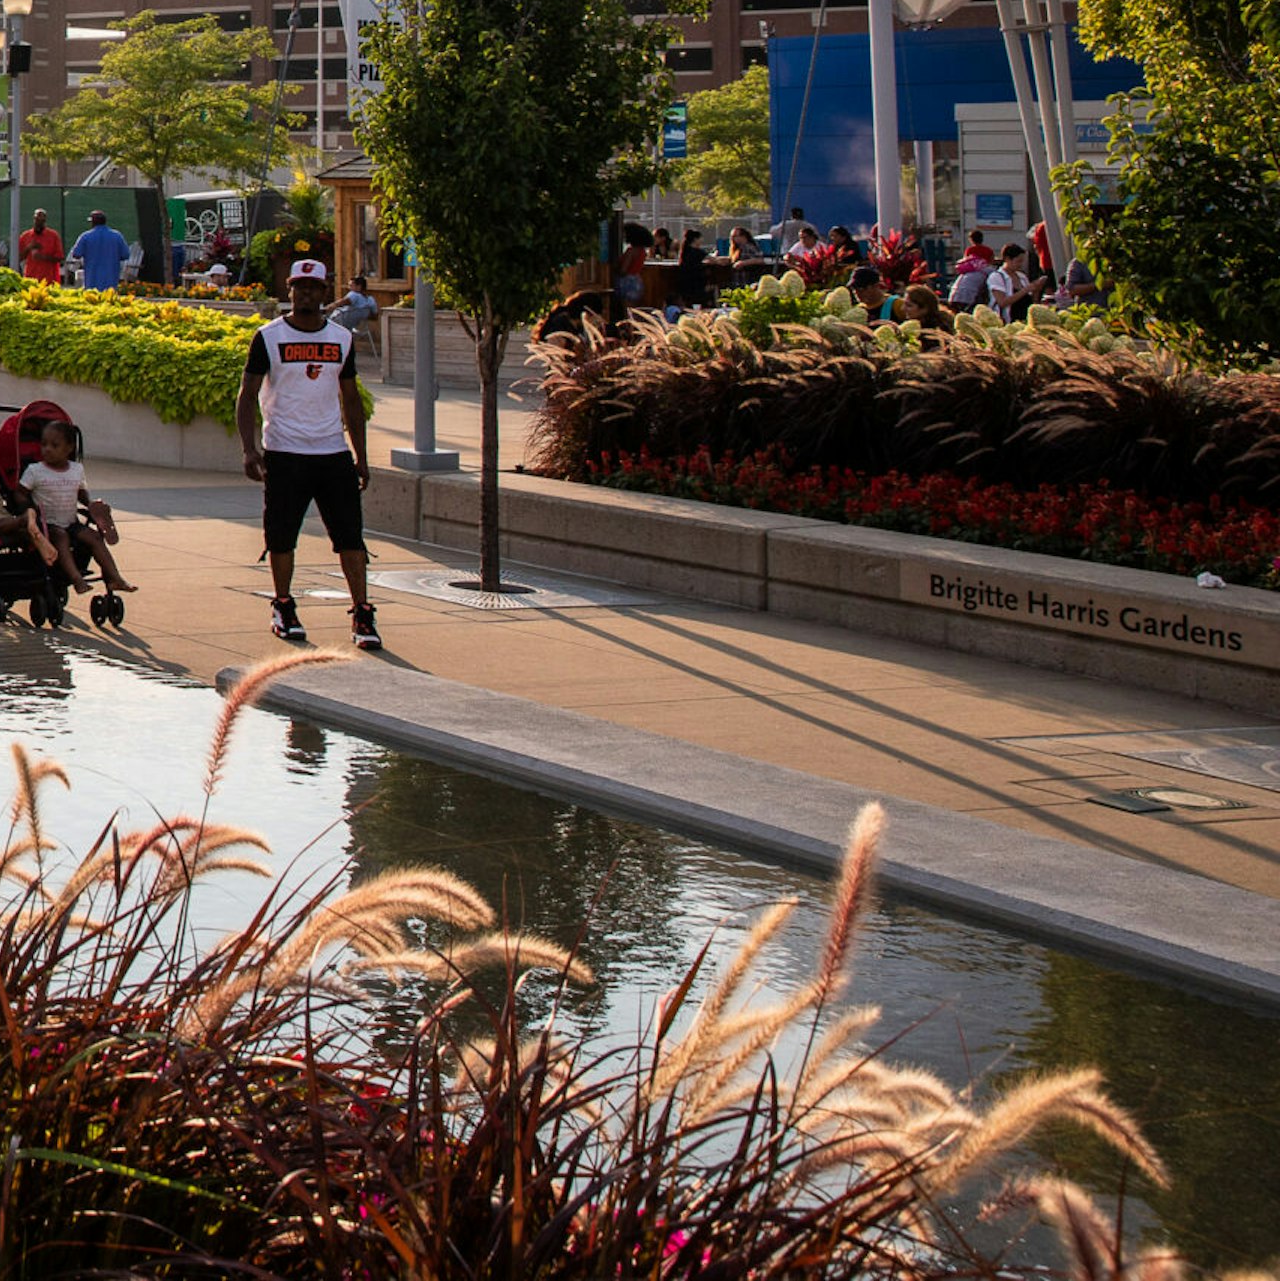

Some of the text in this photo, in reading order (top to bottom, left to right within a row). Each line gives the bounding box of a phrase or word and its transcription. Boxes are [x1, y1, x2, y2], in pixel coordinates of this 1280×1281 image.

[284, 344, 340, 361] ORIOLES
[930, 574, 1243, 651] Brigitte Harris Gardens
